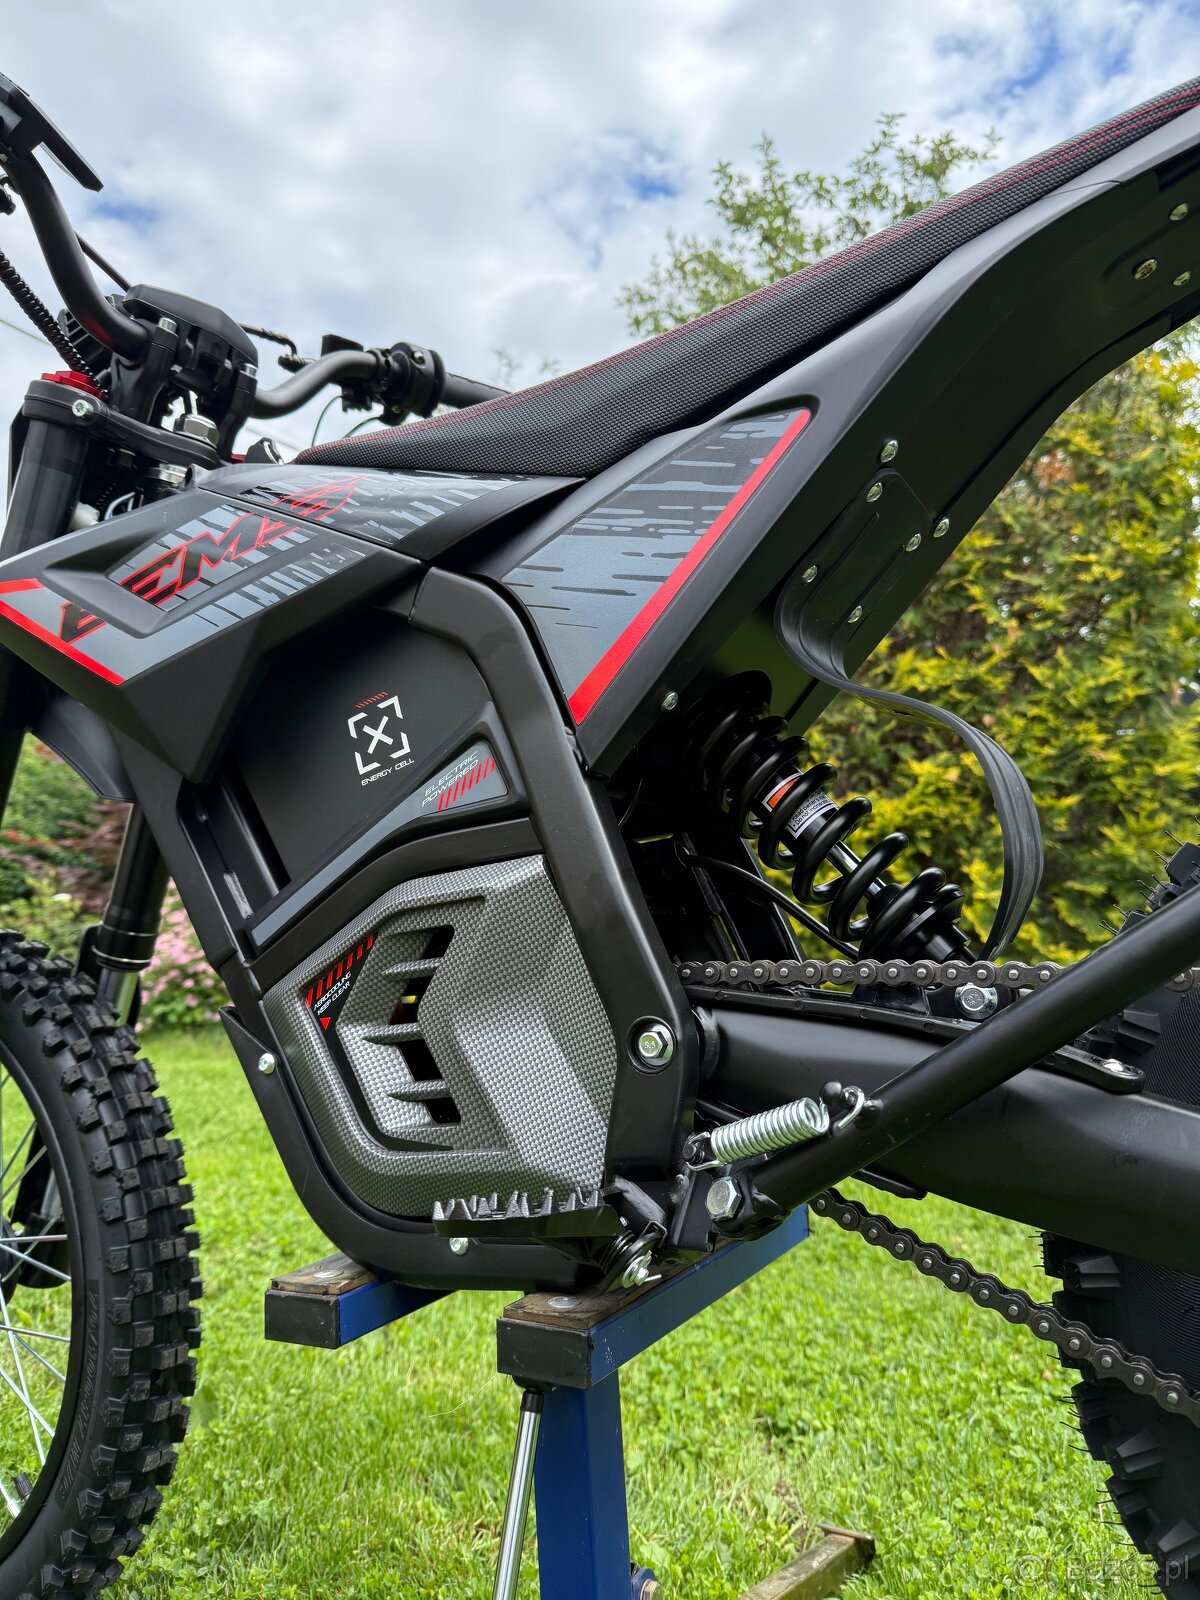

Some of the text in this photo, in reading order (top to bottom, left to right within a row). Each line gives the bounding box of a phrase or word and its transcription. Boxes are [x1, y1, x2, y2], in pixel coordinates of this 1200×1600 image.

[361, 758, 415, 786] ENERGY CELL
[422, 759, 479, 807] POWERED
[425, 751, 478, 796] ELECTRIC
[795, 816, 803, 825] Do
[802, 810, 811, 819] not
[314, 971, 351, 1011] AEROCOOLING
[317, 981, 350, 1016] KEEP CLEAR
